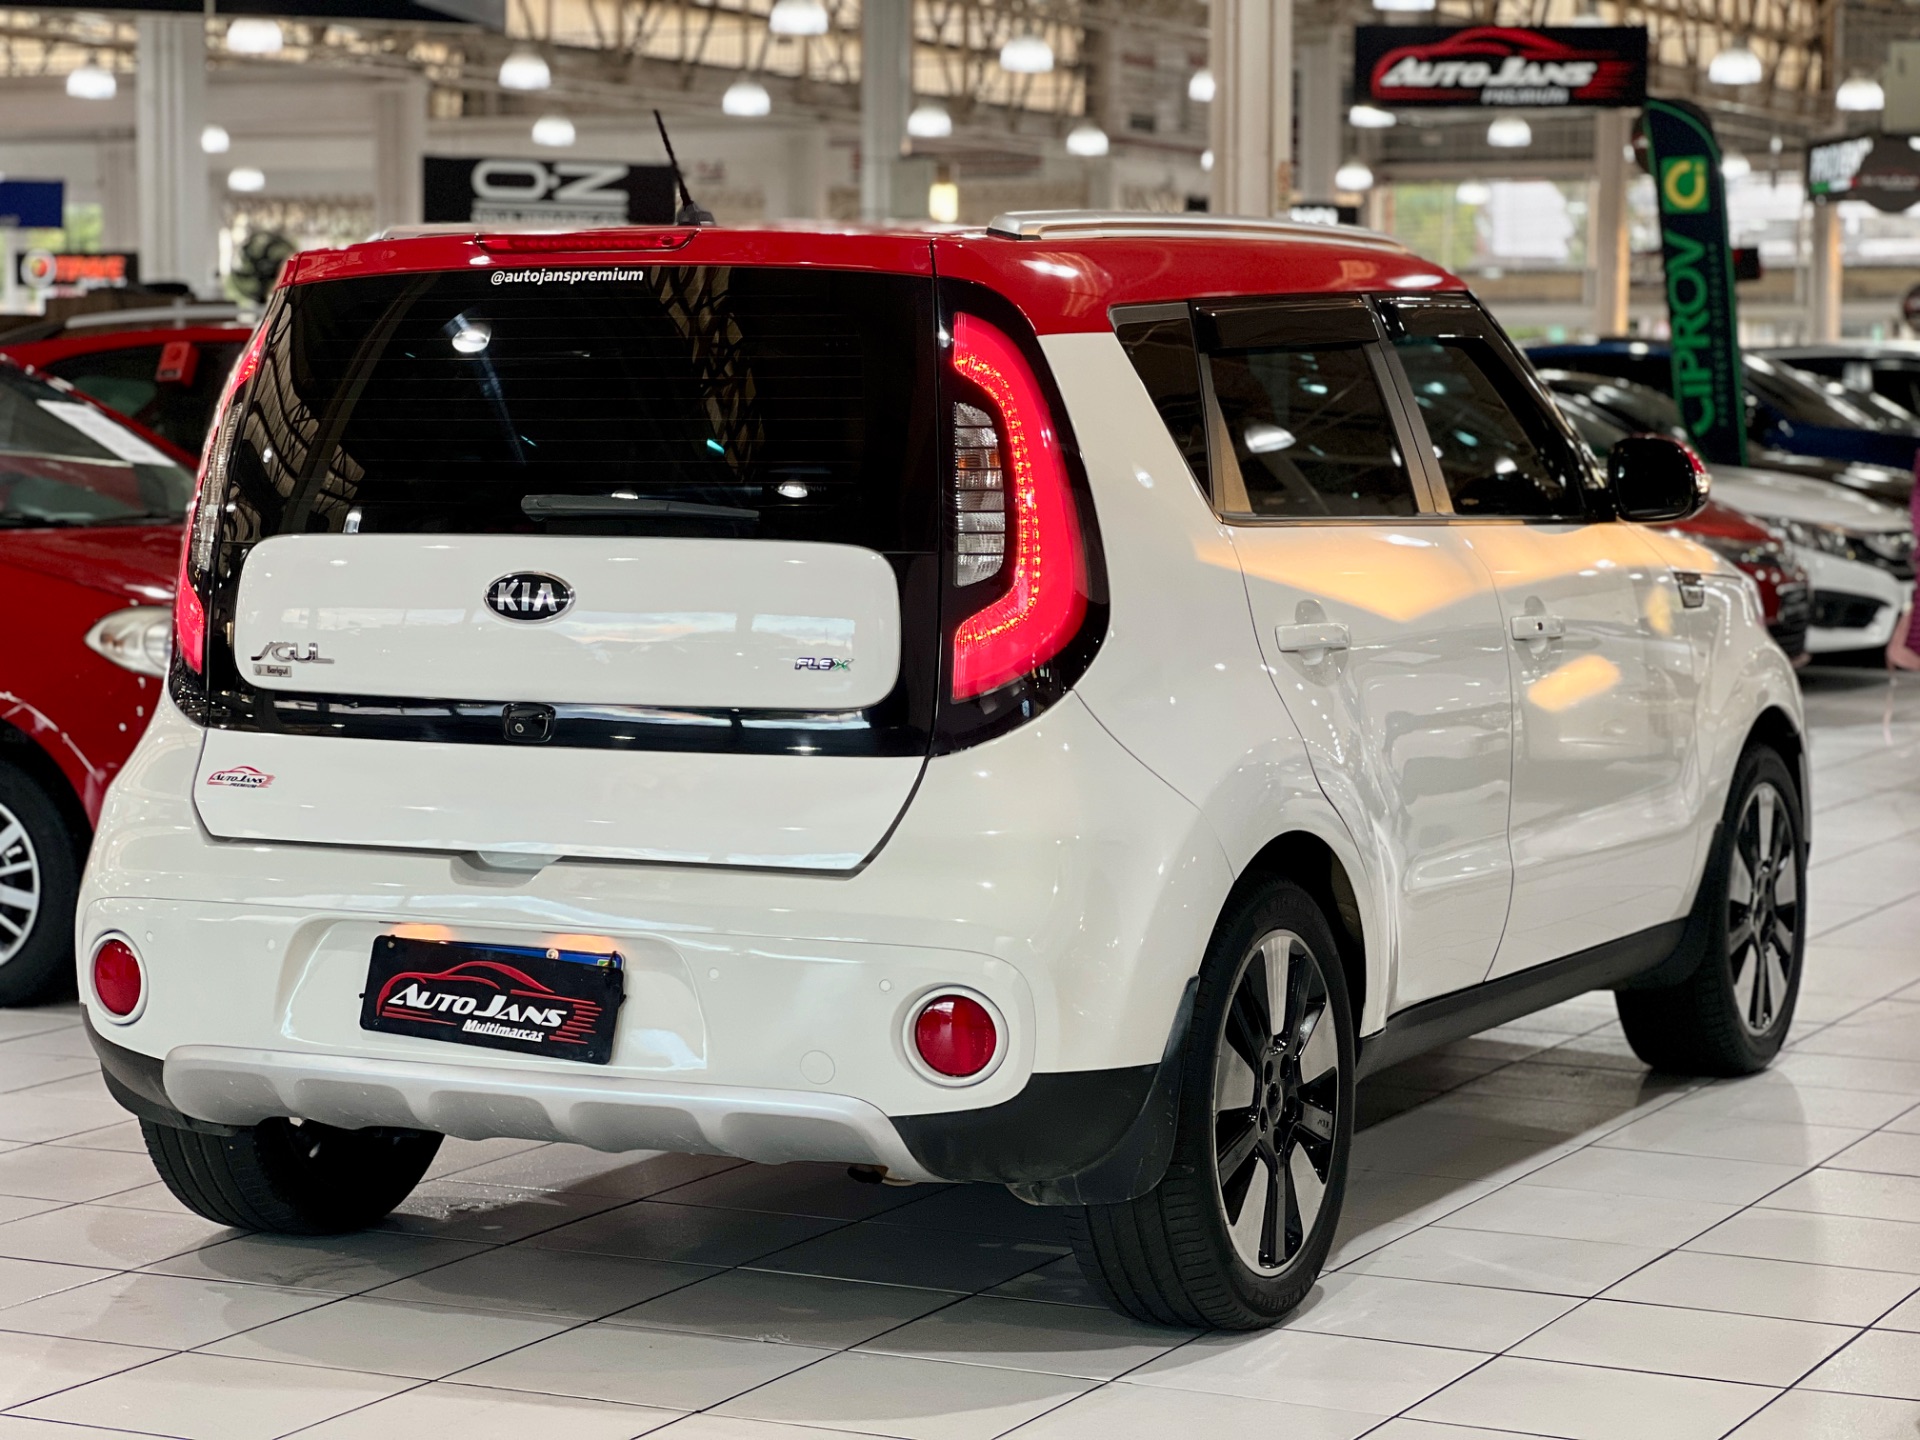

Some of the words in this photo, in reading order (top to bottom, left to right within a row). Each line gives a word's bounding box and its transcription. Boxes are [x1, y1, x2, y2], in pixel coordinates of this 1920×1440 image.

[1380, 56, 1491, 87] AUTO
[1486, 56, 1598, 87] JANS
[490, 267, 644, 285] @autojanspremium
[1664, 228, 1716, 436] CIPROV
[497, 582, 558, 611] KIA
[250, 641, 335, 664] SOUL
[794, 657, 855, 671] FLEX
[387, 982, 478, 1015] AUTO
[473, 994, 568, 1028] JANS
[461, 1018, 545, 1043] Multimarcas
